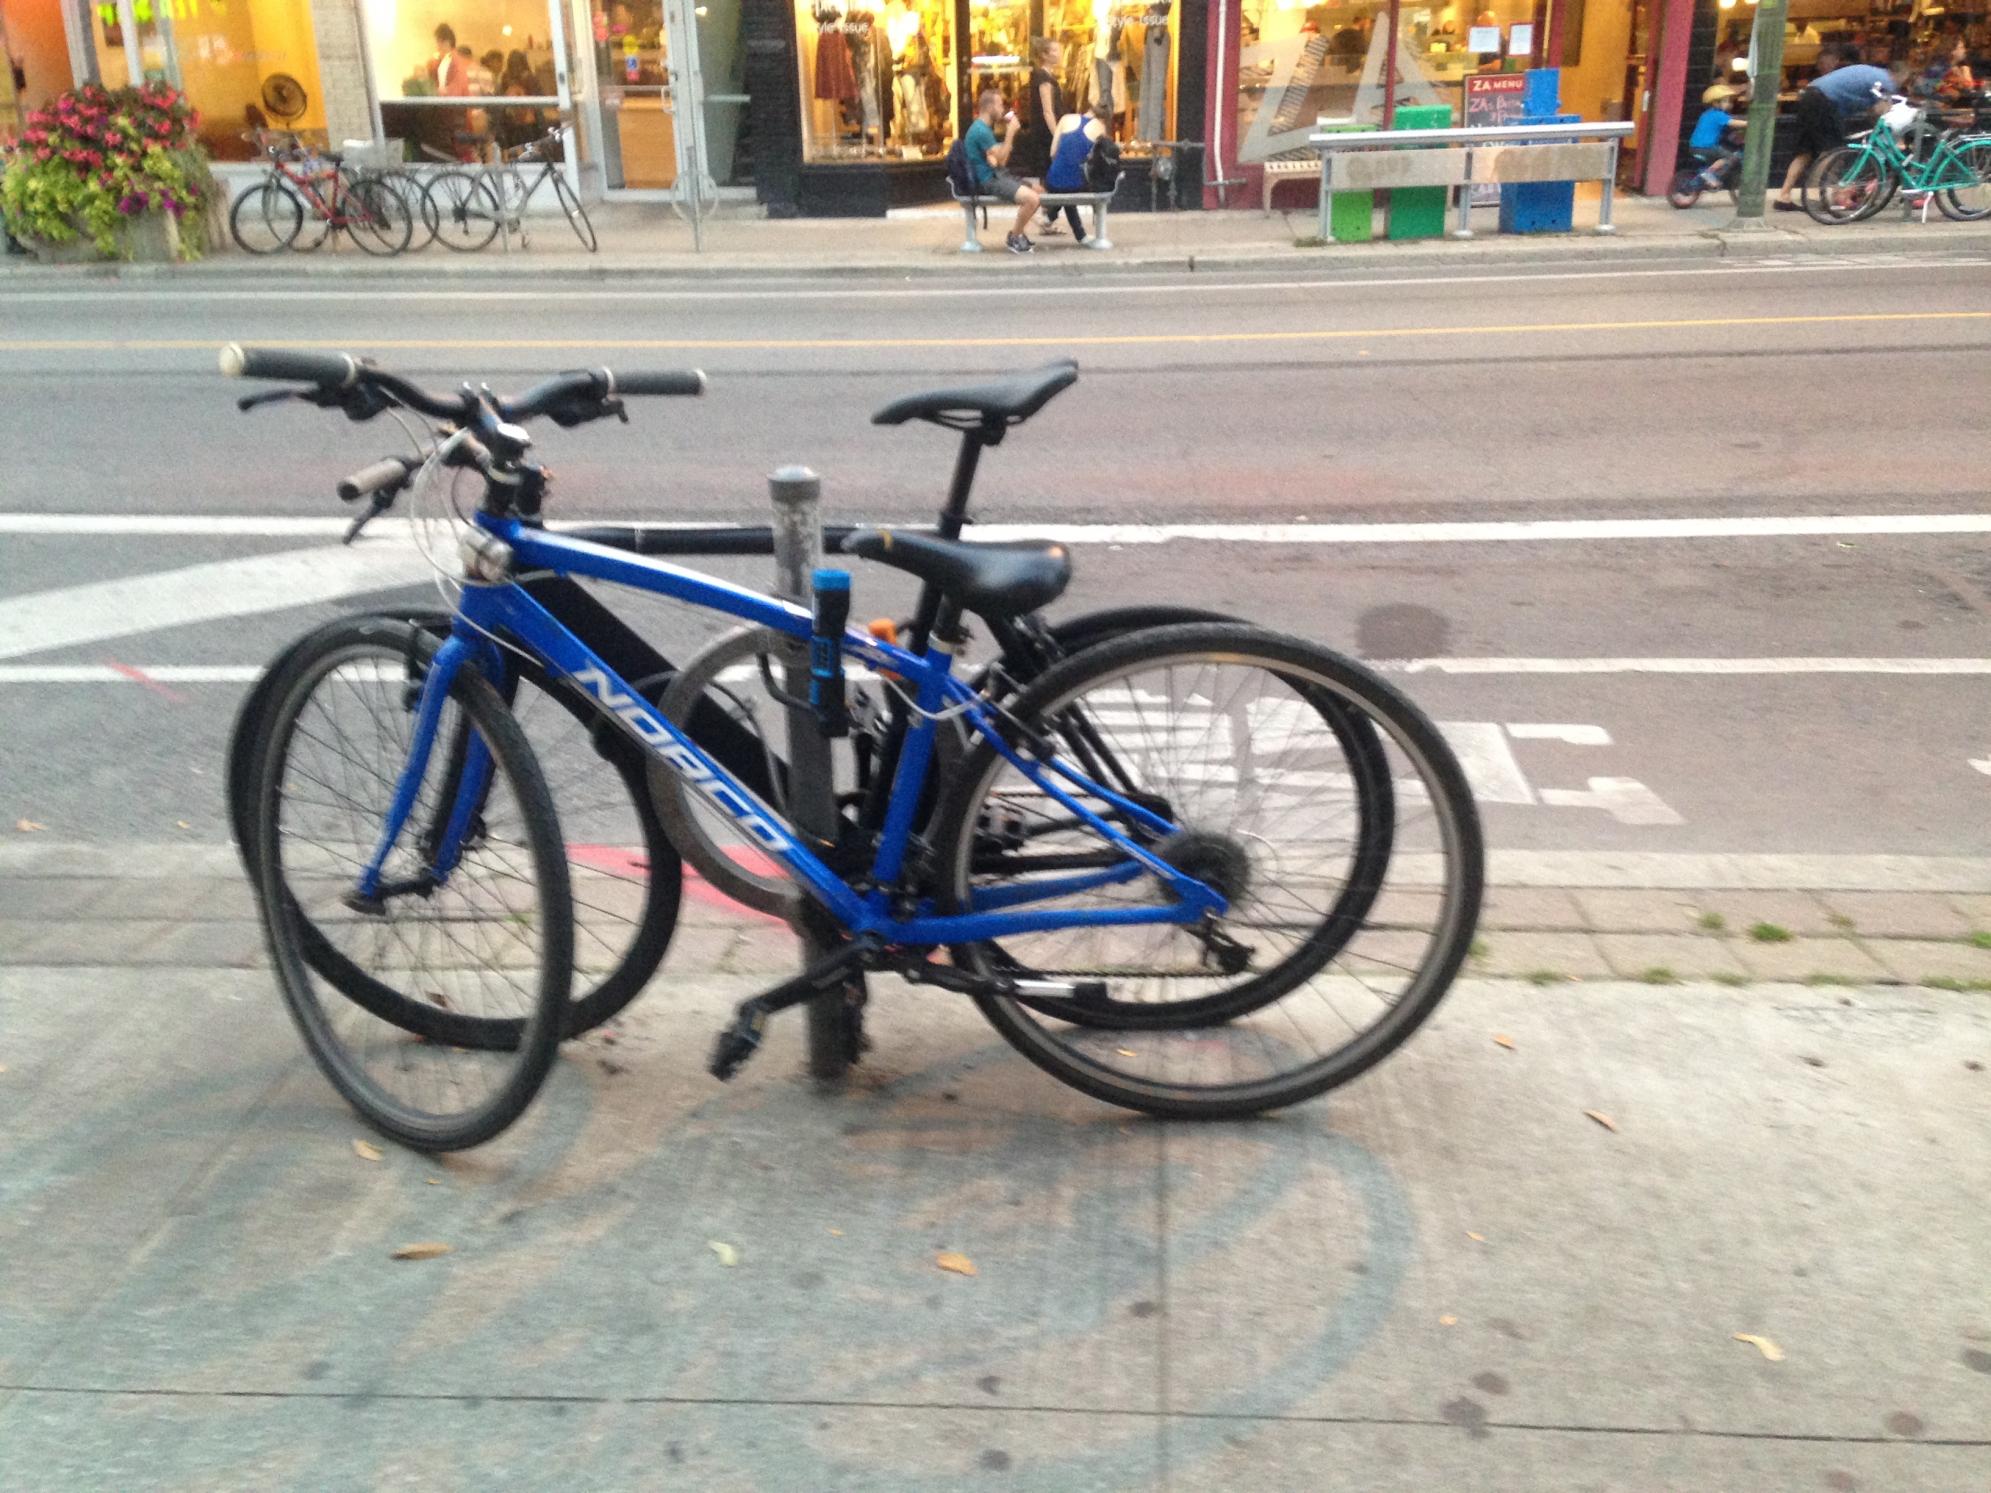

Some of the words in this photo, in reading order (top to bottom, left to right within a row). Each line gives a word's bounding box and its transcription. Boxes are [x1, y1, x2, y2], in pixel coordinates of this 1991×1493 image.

[1473, 80, 1491, 92] ZA
[1493, 80, 1524, 89] MENU
[573, 661, 794, 850] NORCO
